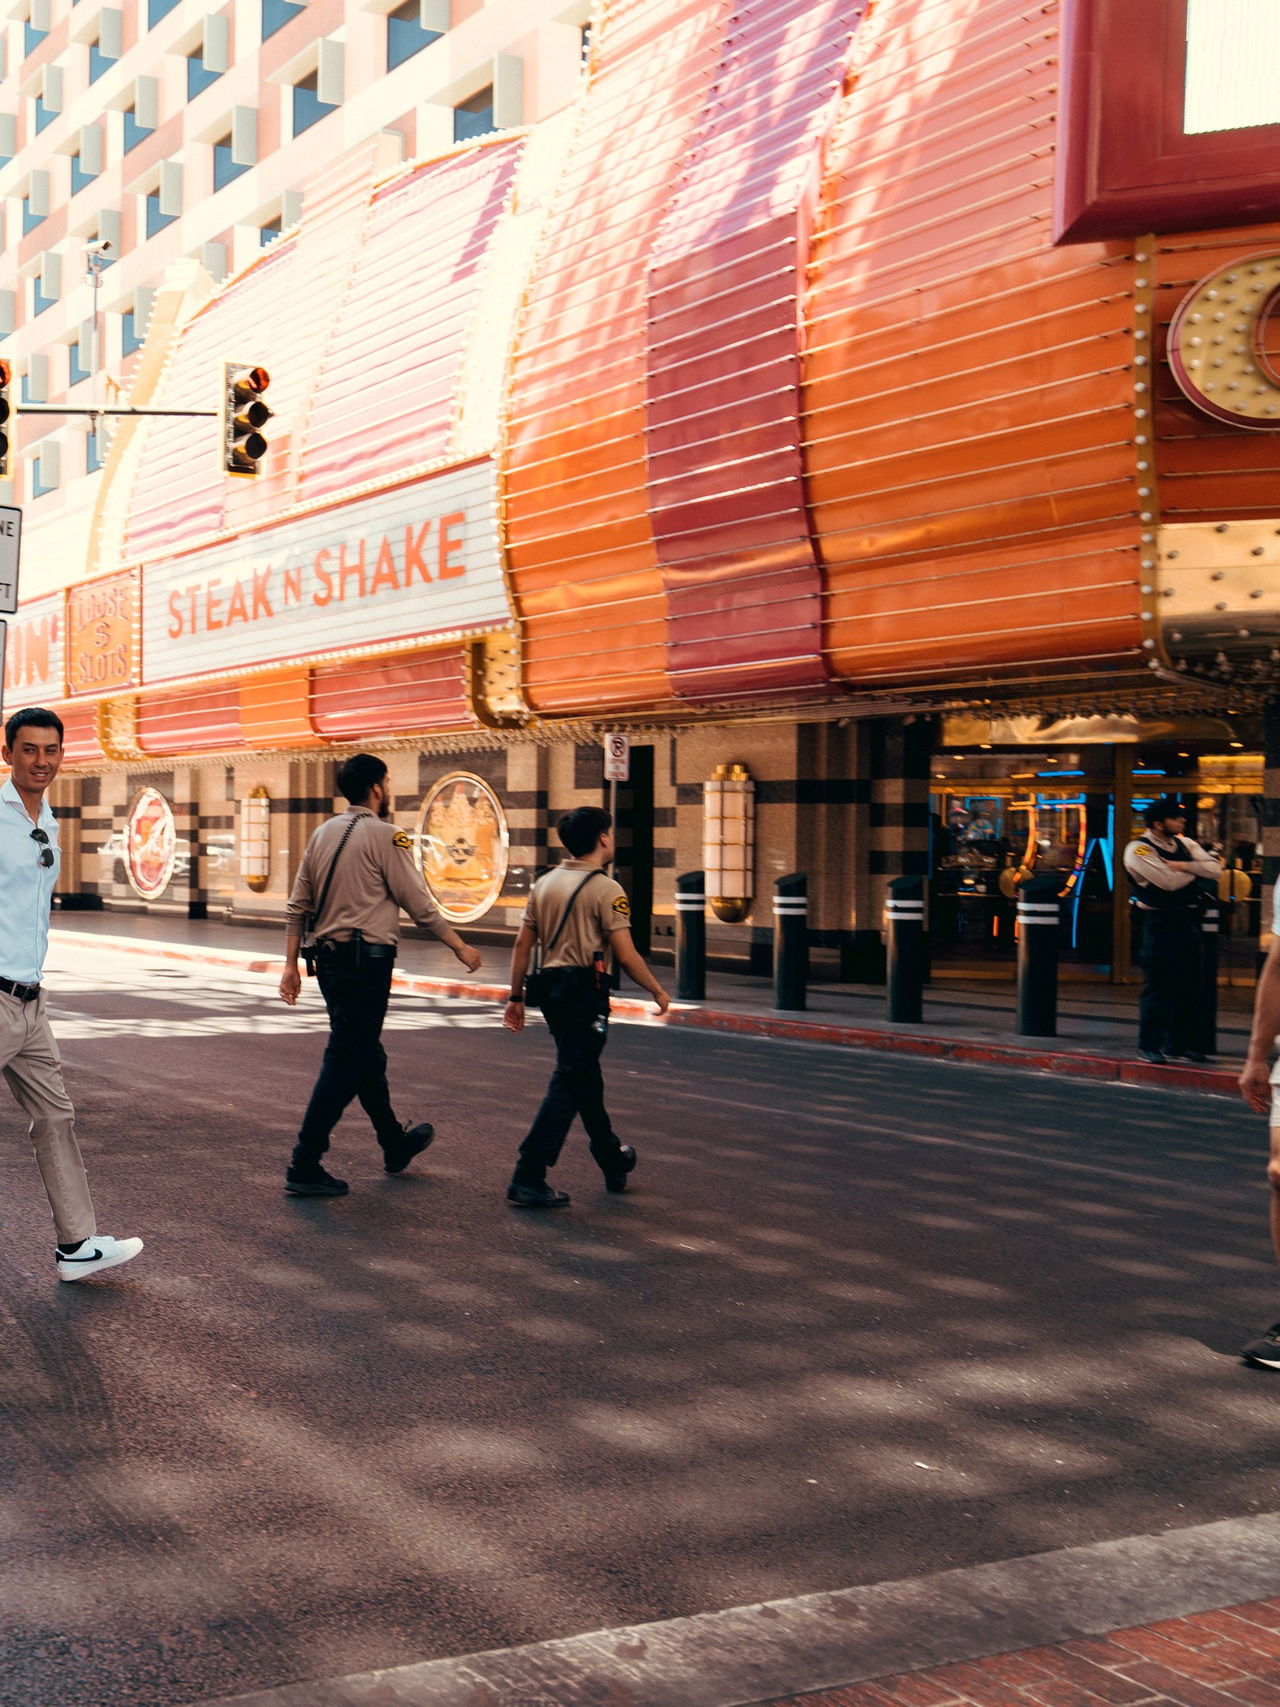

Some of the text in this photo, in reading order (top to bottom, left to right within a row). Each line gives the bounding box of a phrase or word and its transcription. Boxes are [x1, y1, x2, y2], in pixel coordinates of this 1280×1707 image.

[167, 511, 466, 639] STEAK N SHAKE
[78, 643, 128, 684] SLOTS
